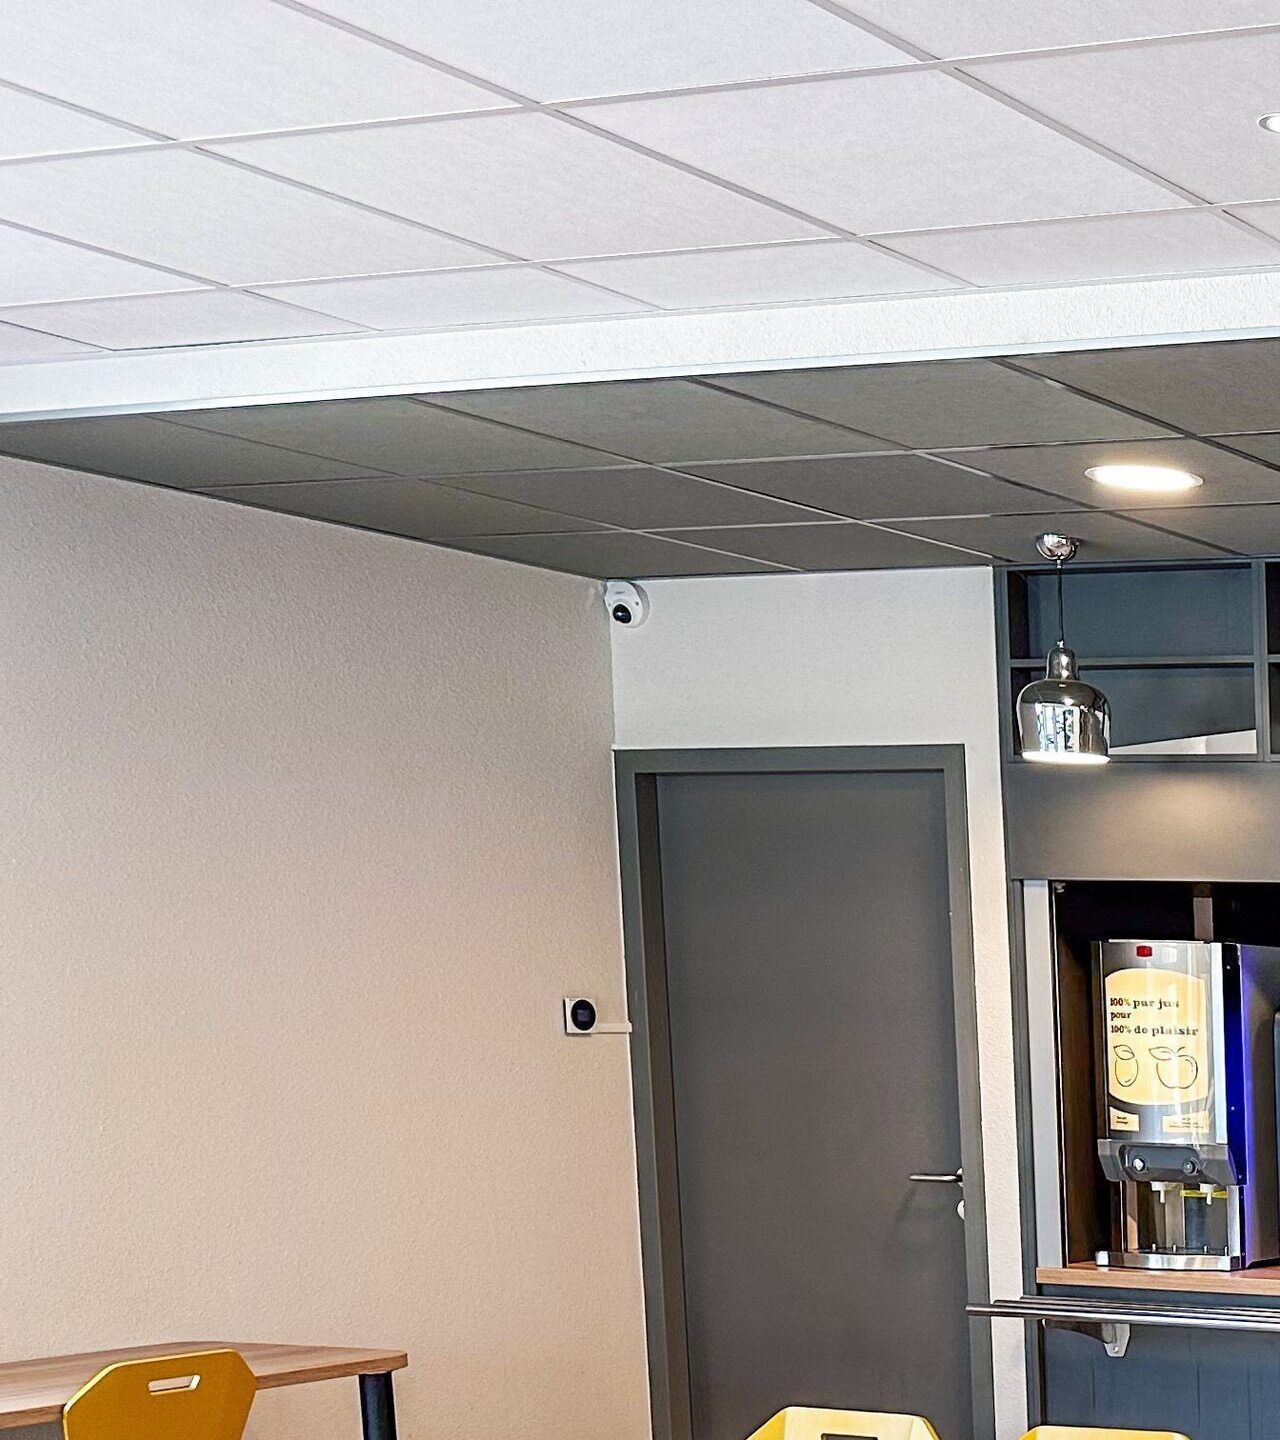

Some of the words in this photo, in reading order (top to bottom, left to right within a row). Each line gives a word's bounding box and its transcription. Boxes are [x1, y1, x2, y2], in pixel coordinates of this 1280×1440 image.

[1110, 997, 1131, 1007] 100%
[1133, 1000, 1154, 1009] pur
[1110, 1011, 1132, 1021] pour
[1111, 1024, 1131, 1034] 100%
[1134, 1025, 1148, 1034] de
